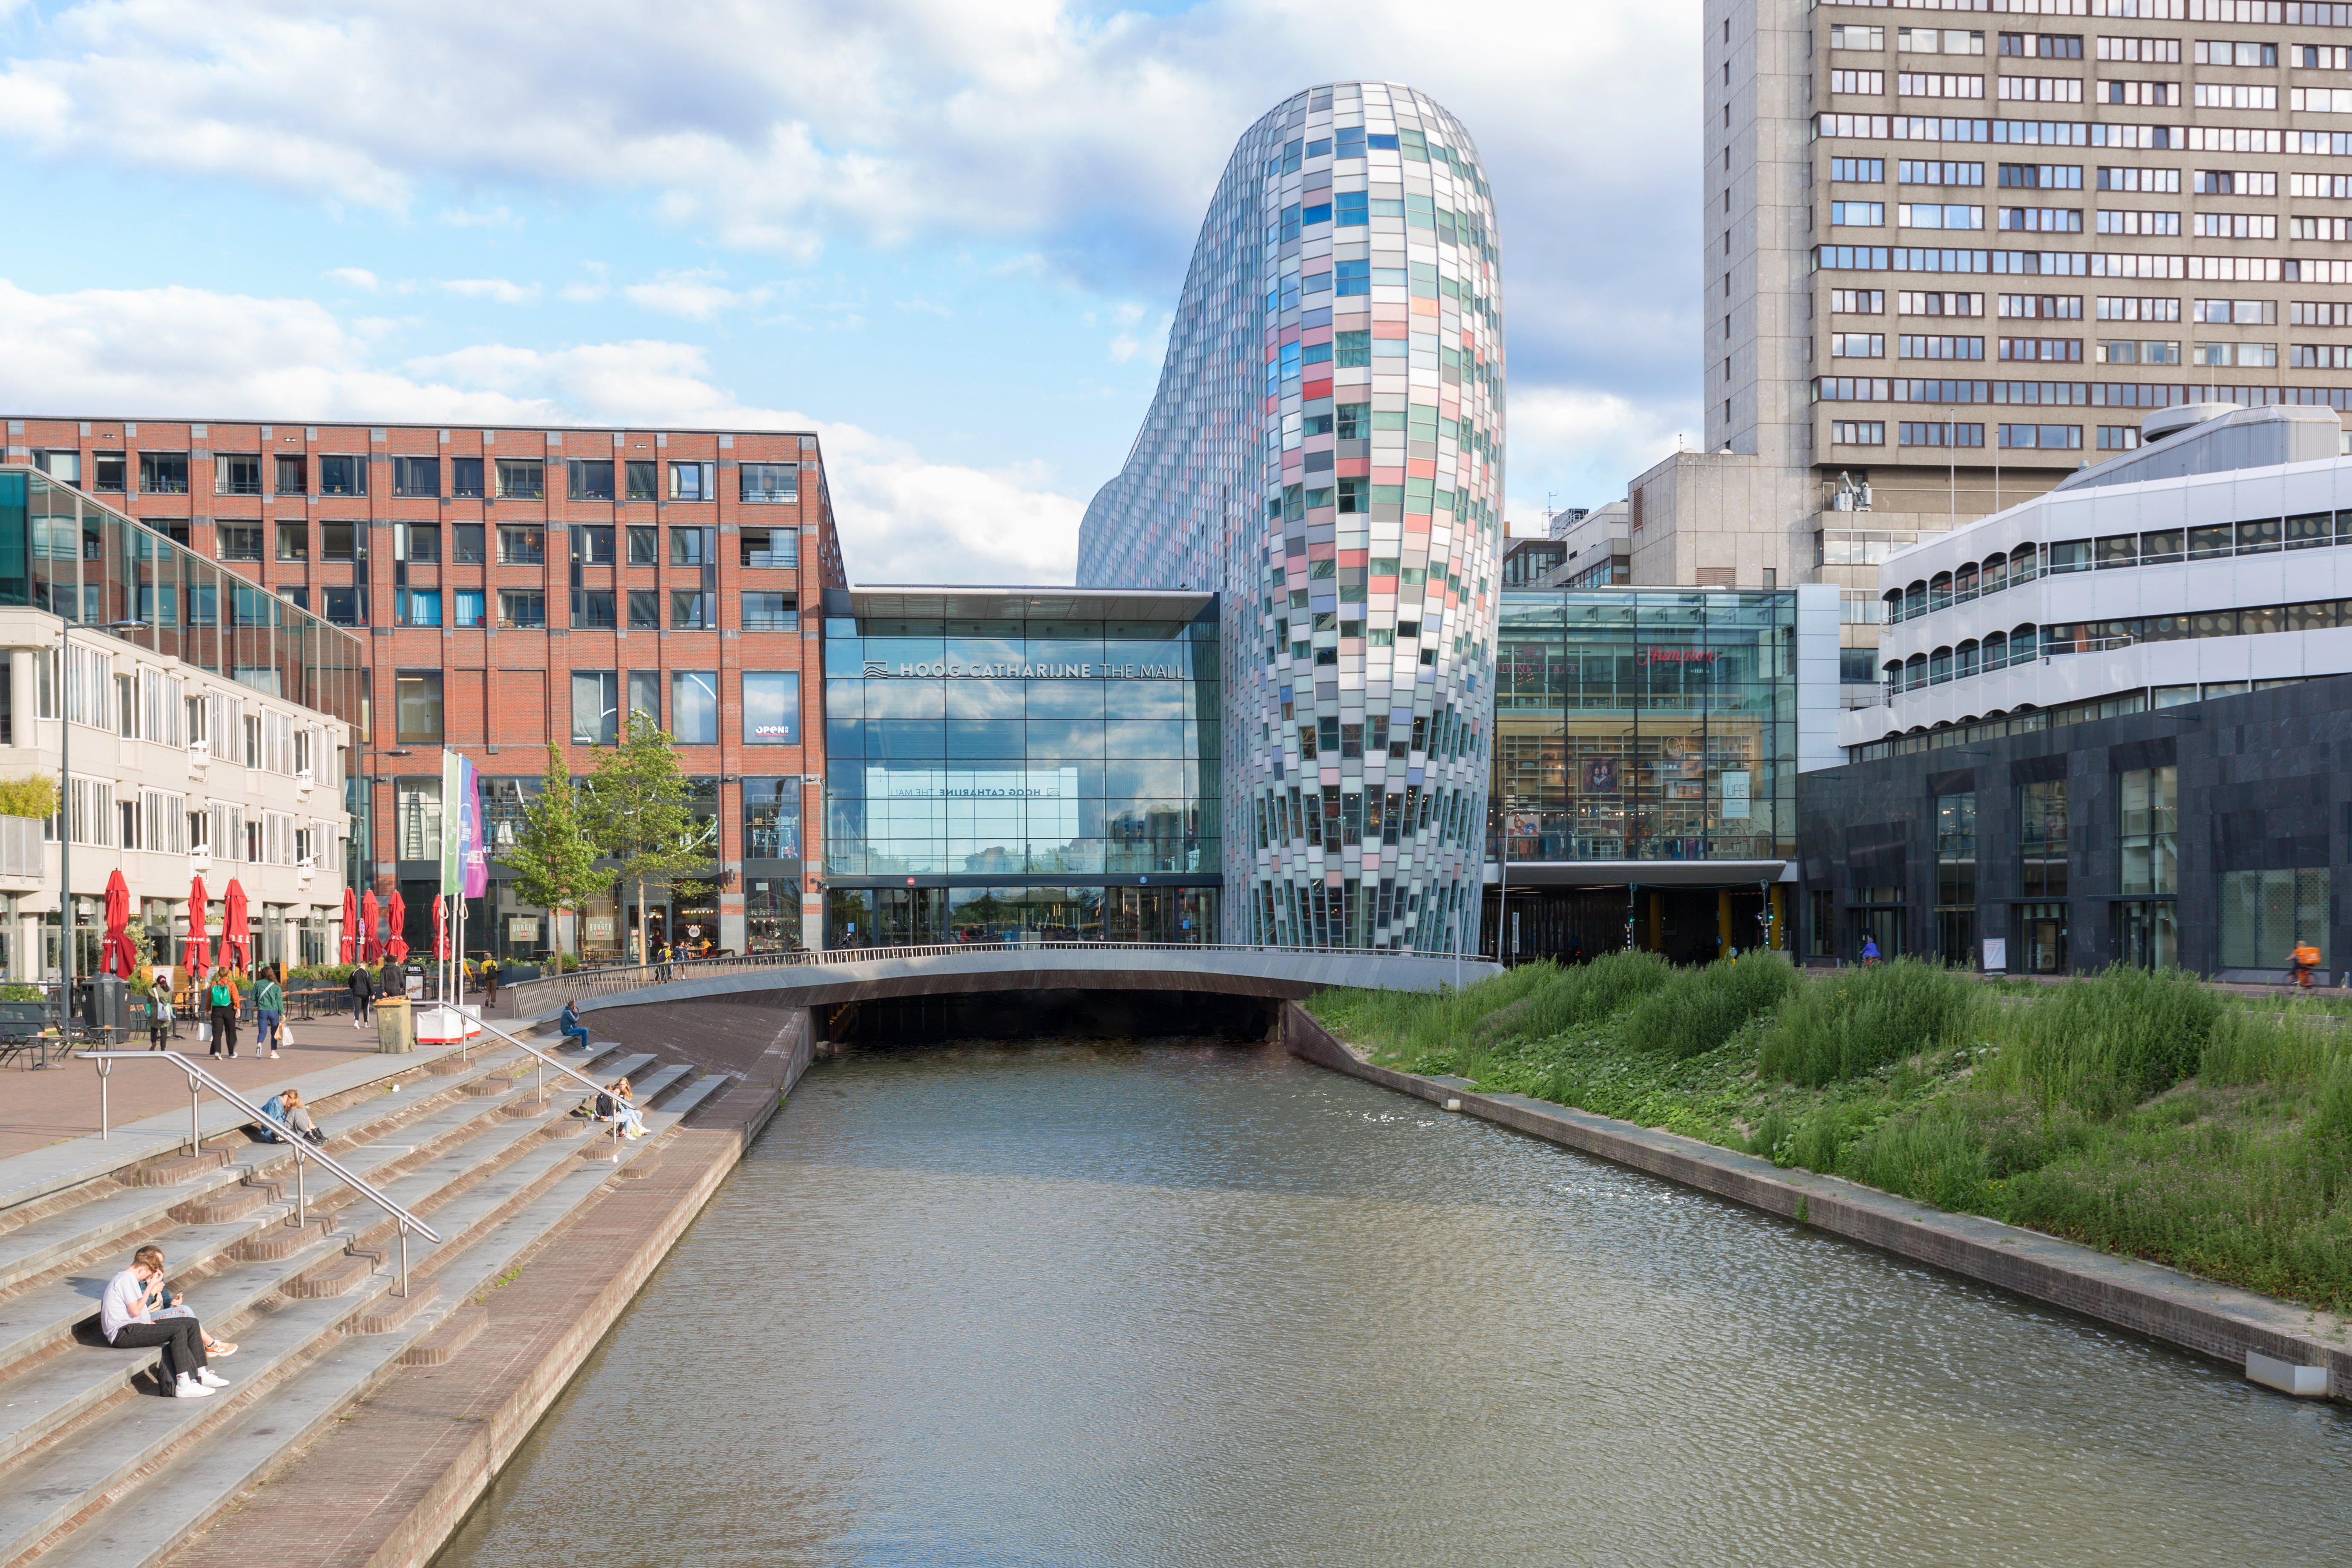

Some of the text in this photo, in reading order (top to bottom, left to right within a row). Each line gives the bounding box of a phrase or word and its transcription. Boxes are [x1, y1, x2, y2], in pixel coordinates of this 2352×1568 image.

[1636, 645, 1720, 666] Hampton
[900, 663, 1185, 679] HOOG CATHARIJNE THE MALL
[1727, 784, 1745, 797] LIFE
[513, 924, 535, 932] BURGER
[590, 923, 612, 931] BURGER
